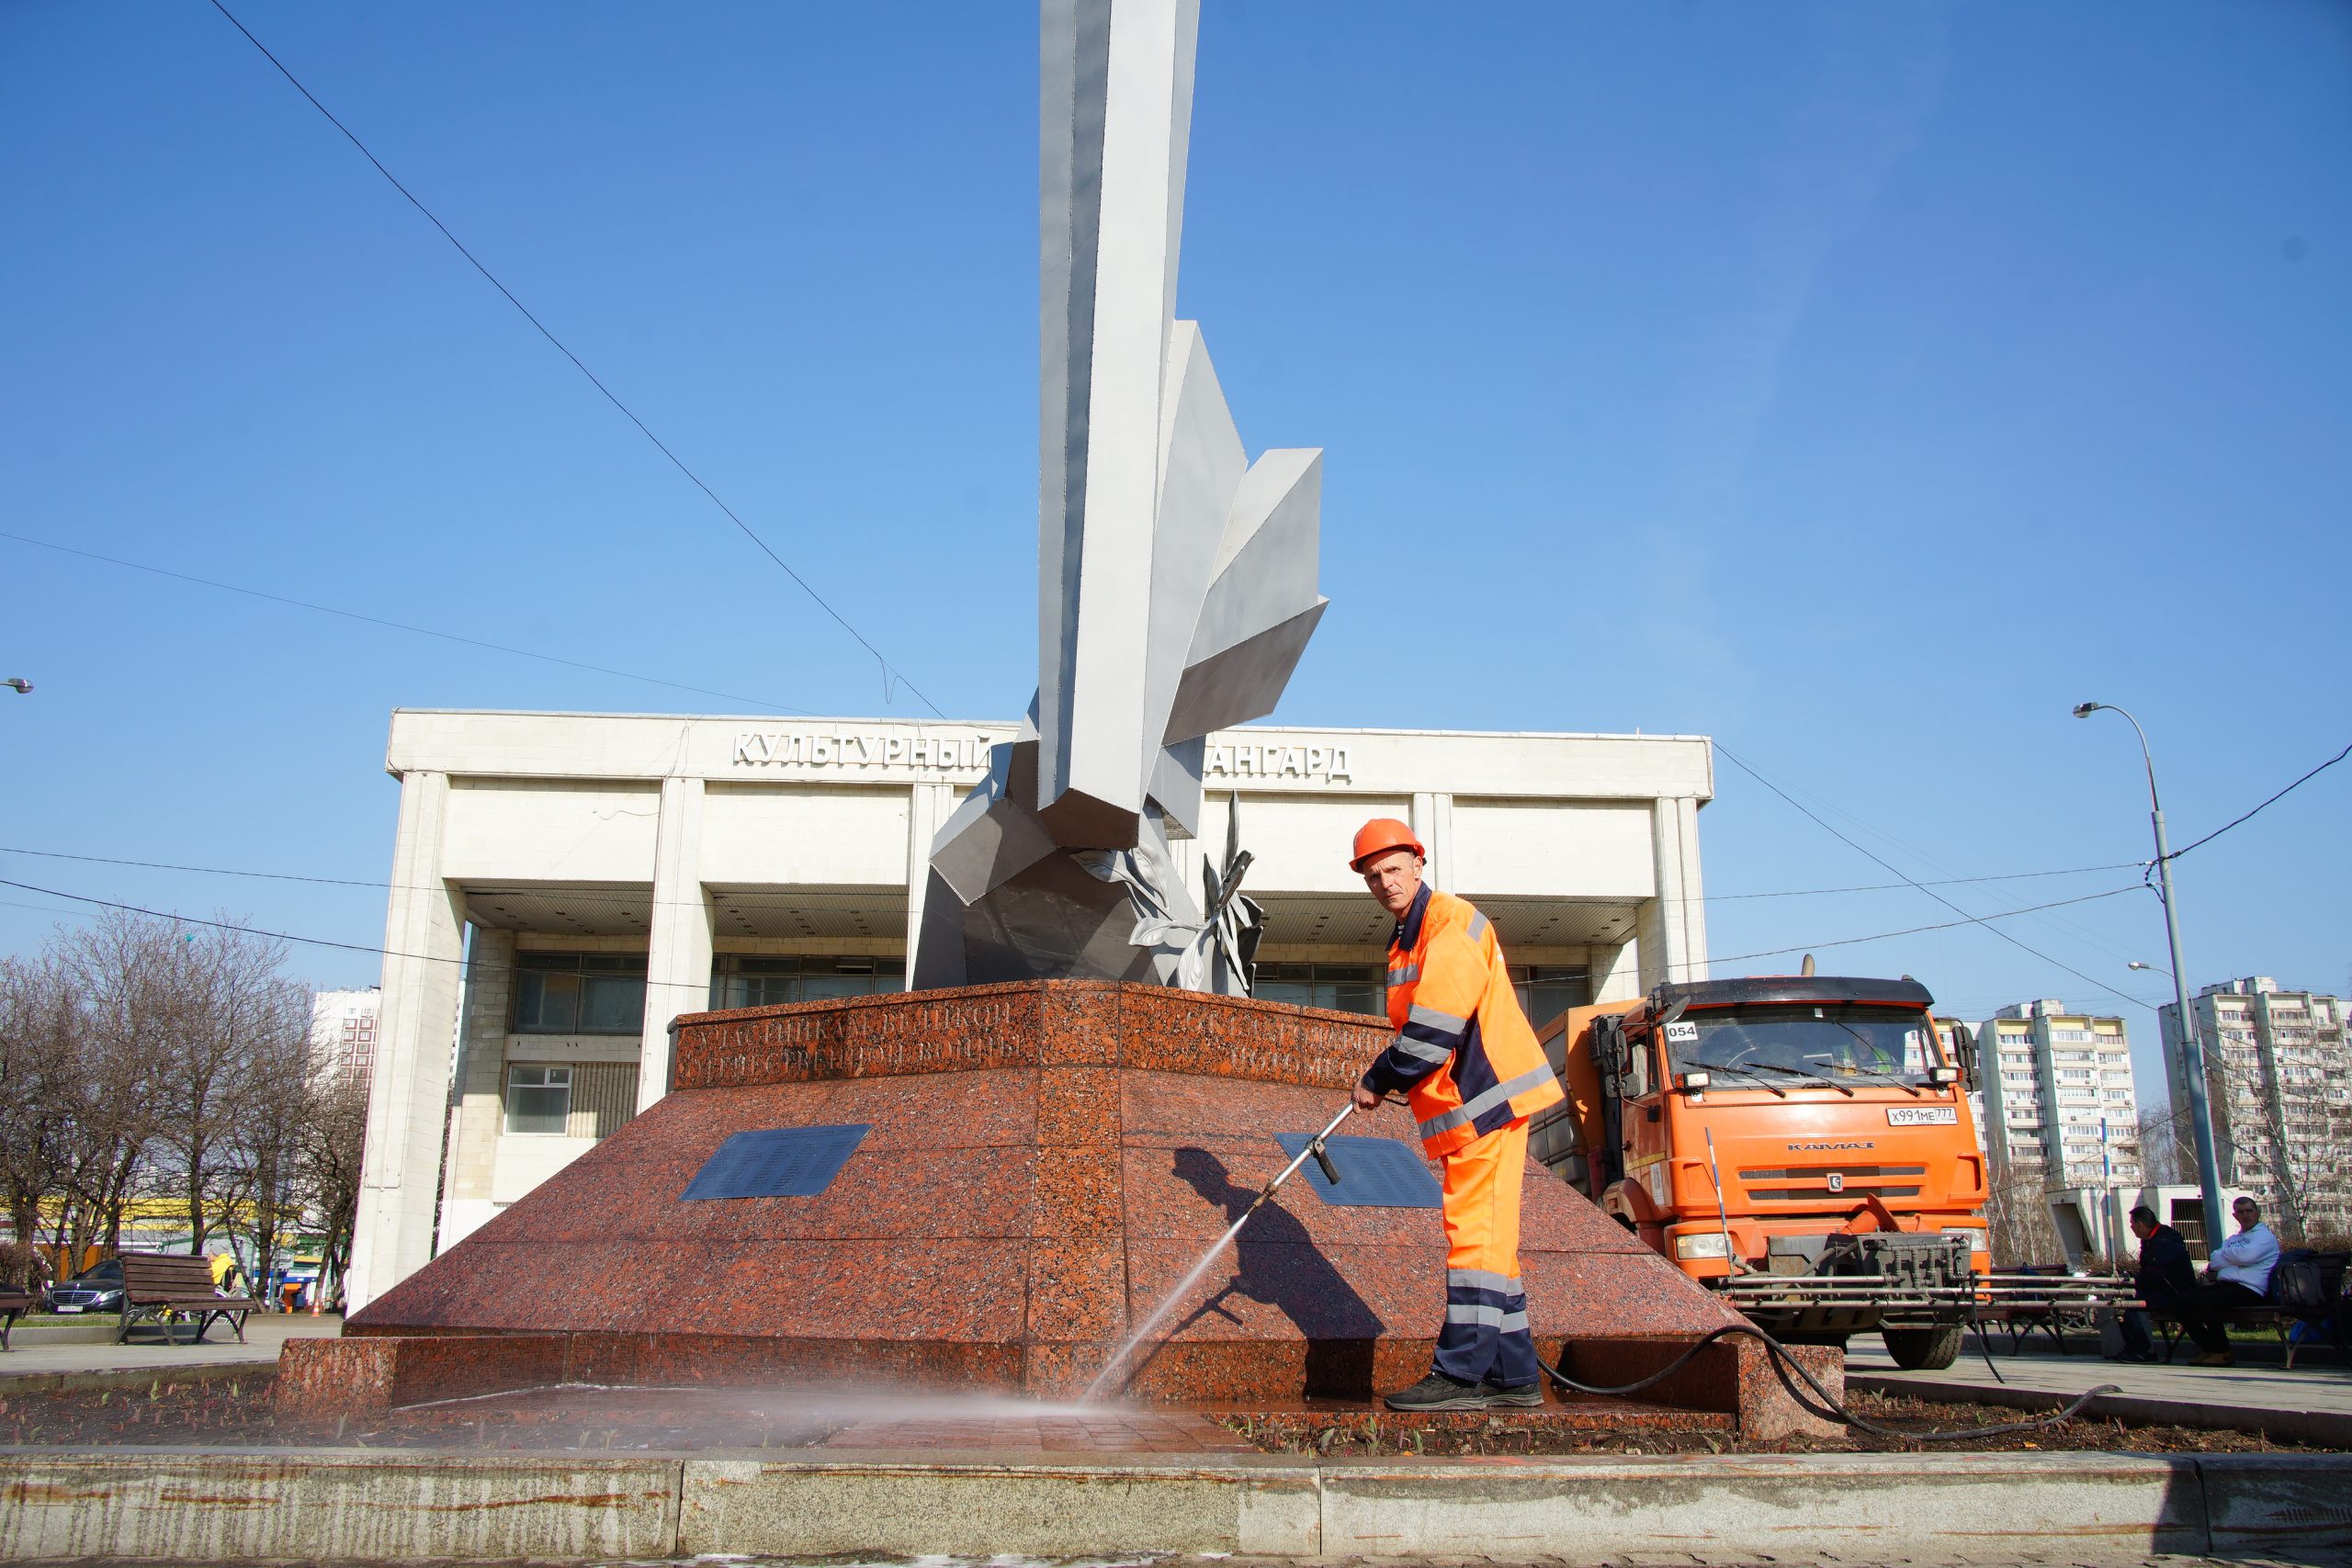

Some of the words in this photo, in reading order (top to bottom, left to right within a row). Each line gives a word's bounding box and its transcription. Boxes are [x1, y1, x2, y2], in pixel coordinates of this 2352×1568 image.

[732, 734, 991, 769] КУЛЬТУРНЫЙ
[1668, 1026, 1695, 1037] 054
[1788, 1142, 1875, 1151] КАМАЗ
